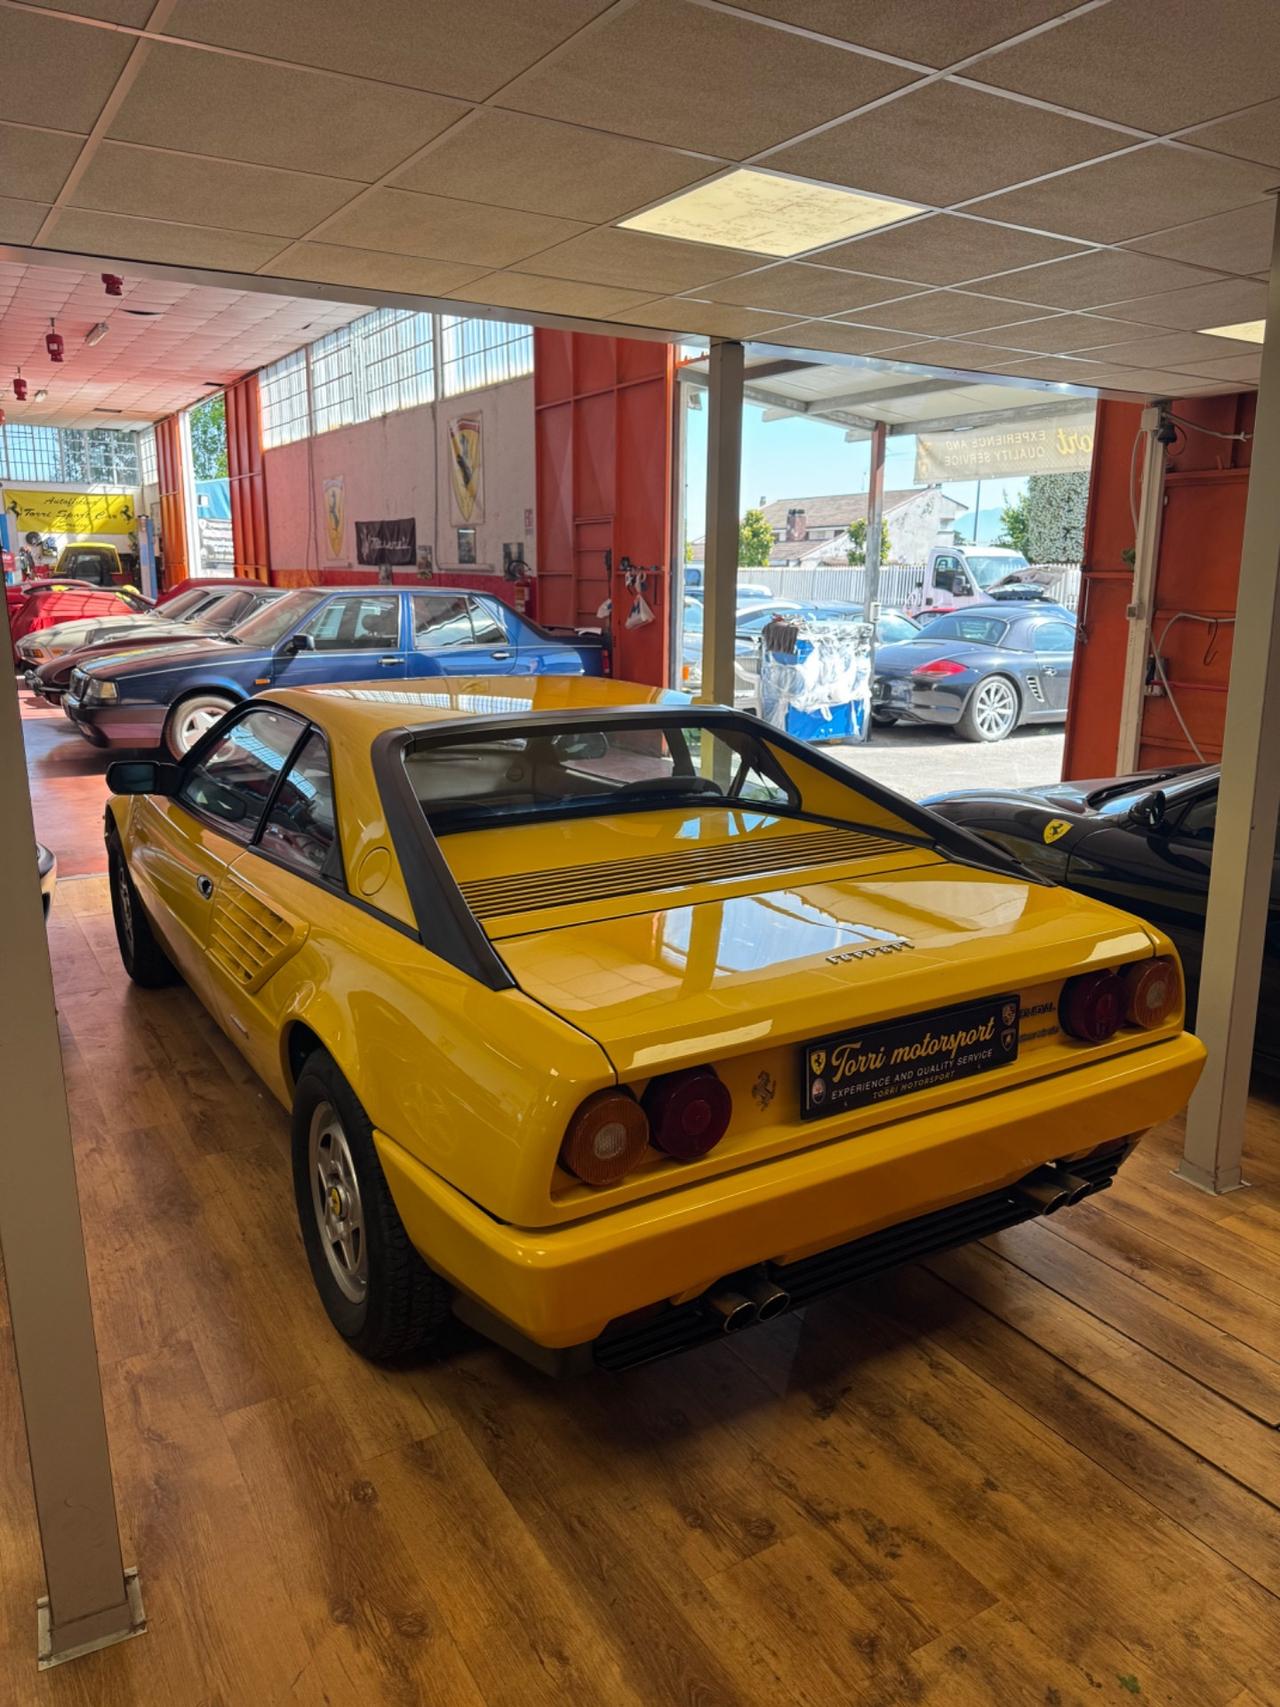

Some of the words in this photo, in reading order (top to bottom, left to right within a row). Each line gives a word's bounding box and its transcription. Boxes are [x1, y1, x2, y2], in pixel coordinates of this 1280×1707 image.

[56, 510, 92, 521] Sport
[831, 1041, 886, 1083] Torri
[890, 1016, 995, 1066] motorsport
[831, 1077, 891, 1100] EXPERIENCE
[894, 1070, 915, 1083] AND
[917, 1060, 955, 1077] QUALITY
[956, 1049, 993, 1066] SERVICE
[872, 1087, 898, 1099] TORRI
[901, 1071, 956, 1092] MOTORSPORT
